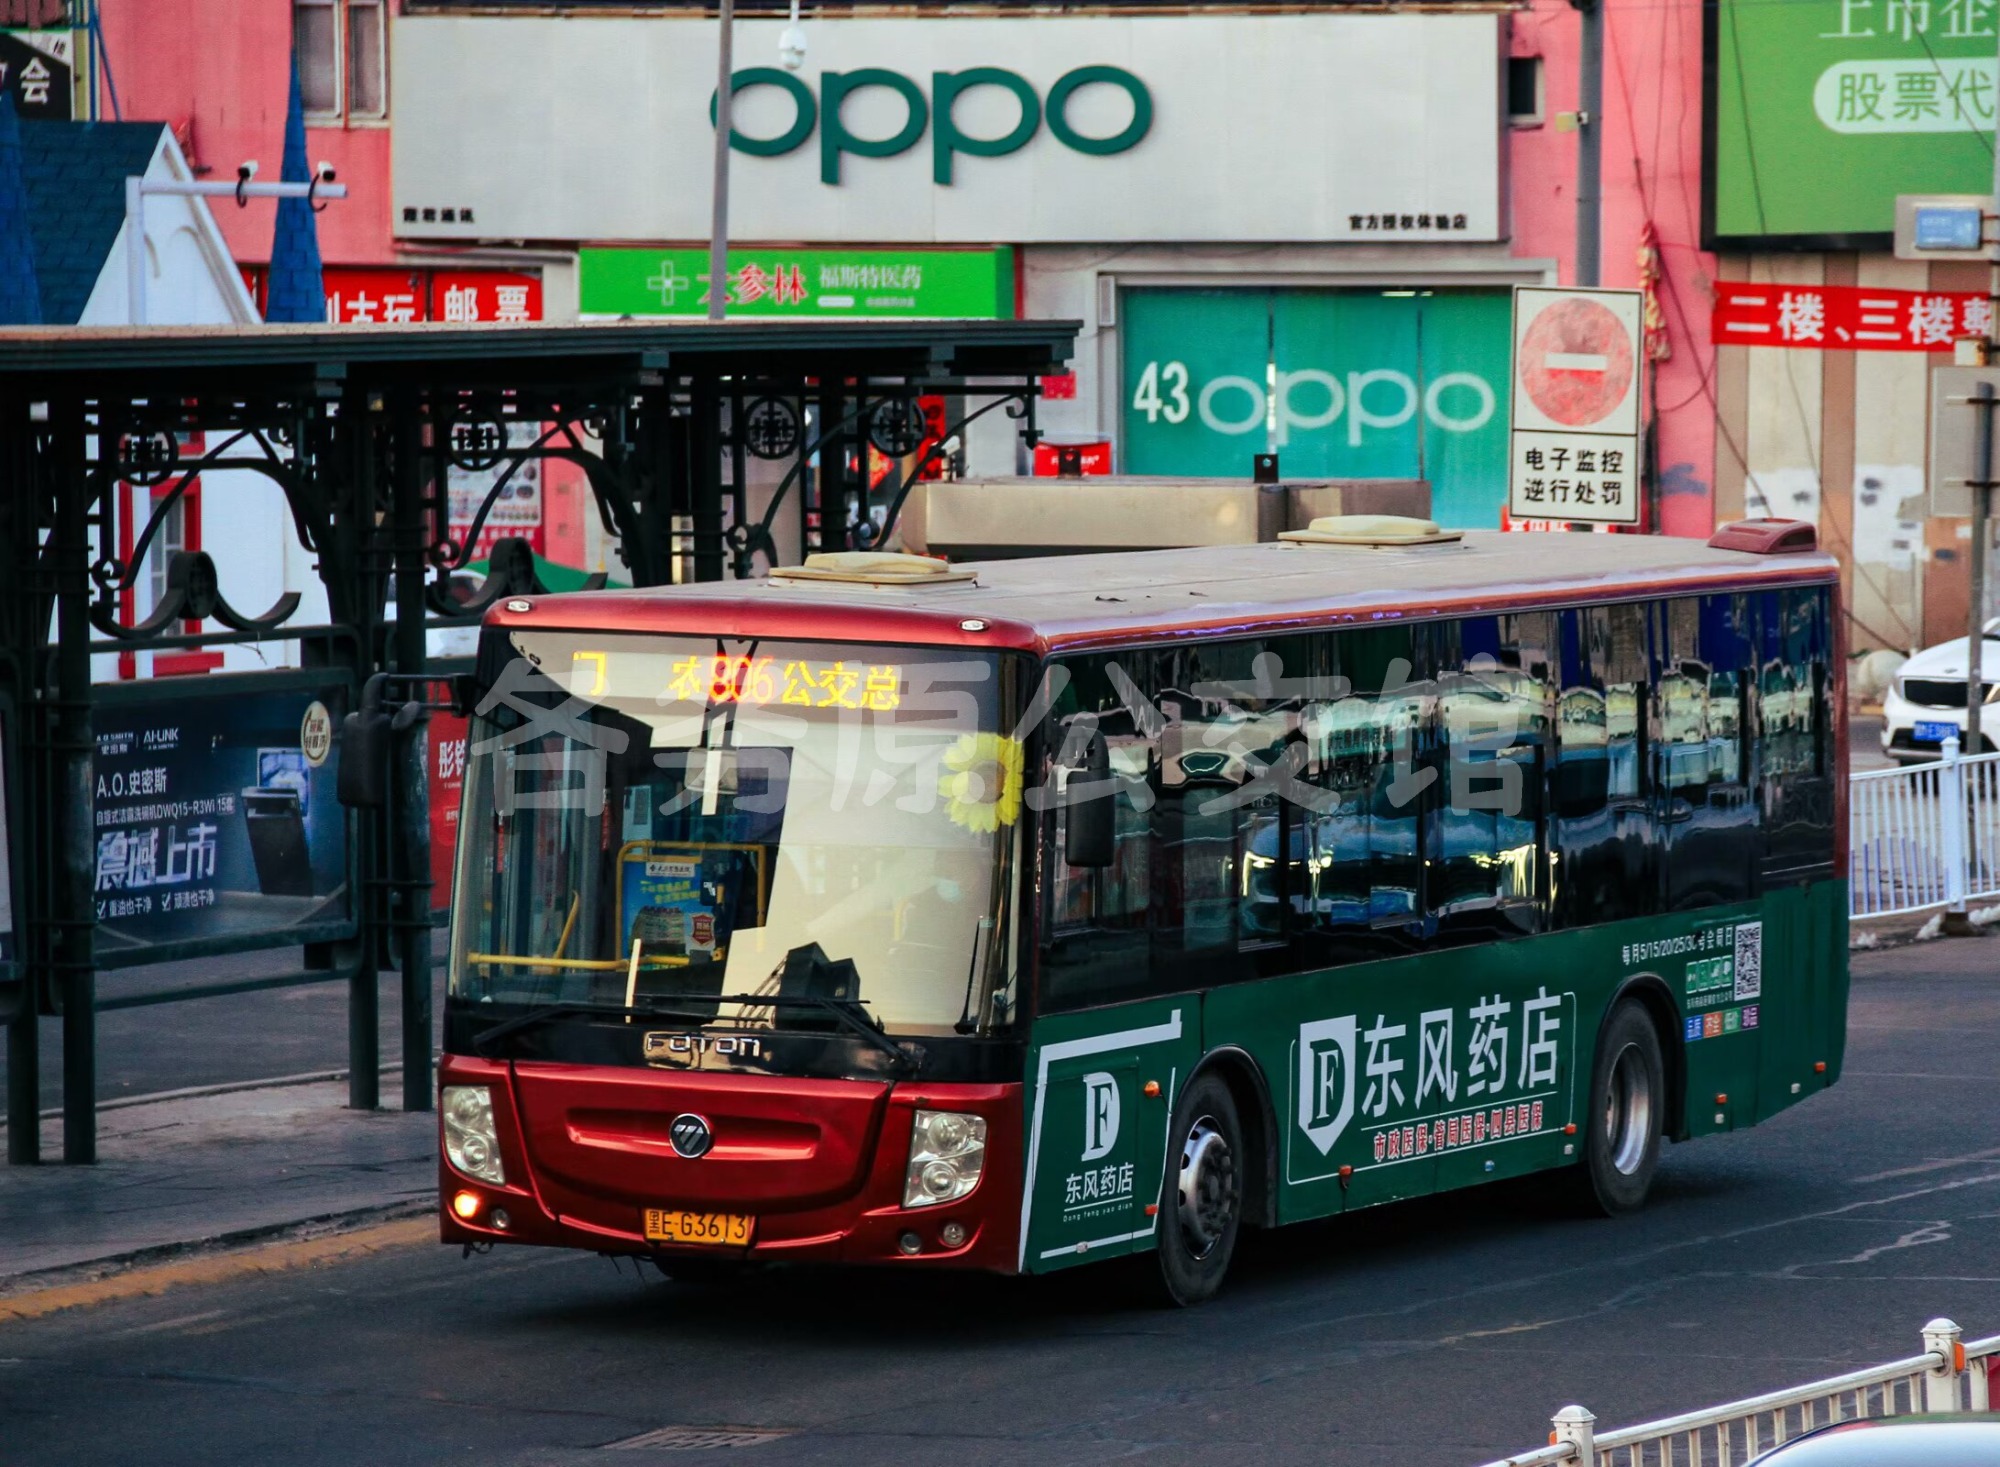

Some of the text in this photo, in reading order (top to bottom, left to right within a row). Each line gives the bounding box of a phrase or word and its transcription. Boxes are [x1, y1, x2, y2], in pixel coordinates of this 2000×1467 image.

[1836, 69, 1994, 121] 股票代
[444, 284, 530, 322] 邮票
[1524, 447, 1623, 473] 电子监控
[1524, 478, 1622, 505] 逆行处罚
[96, 767, 167, 799] A.O.史密斯
[646, 1034, 761, 1057] FOTON
[1361, 986, 1562, 1118] 东风药店
[1065, 1161, 1134, 1204] 东风药店
